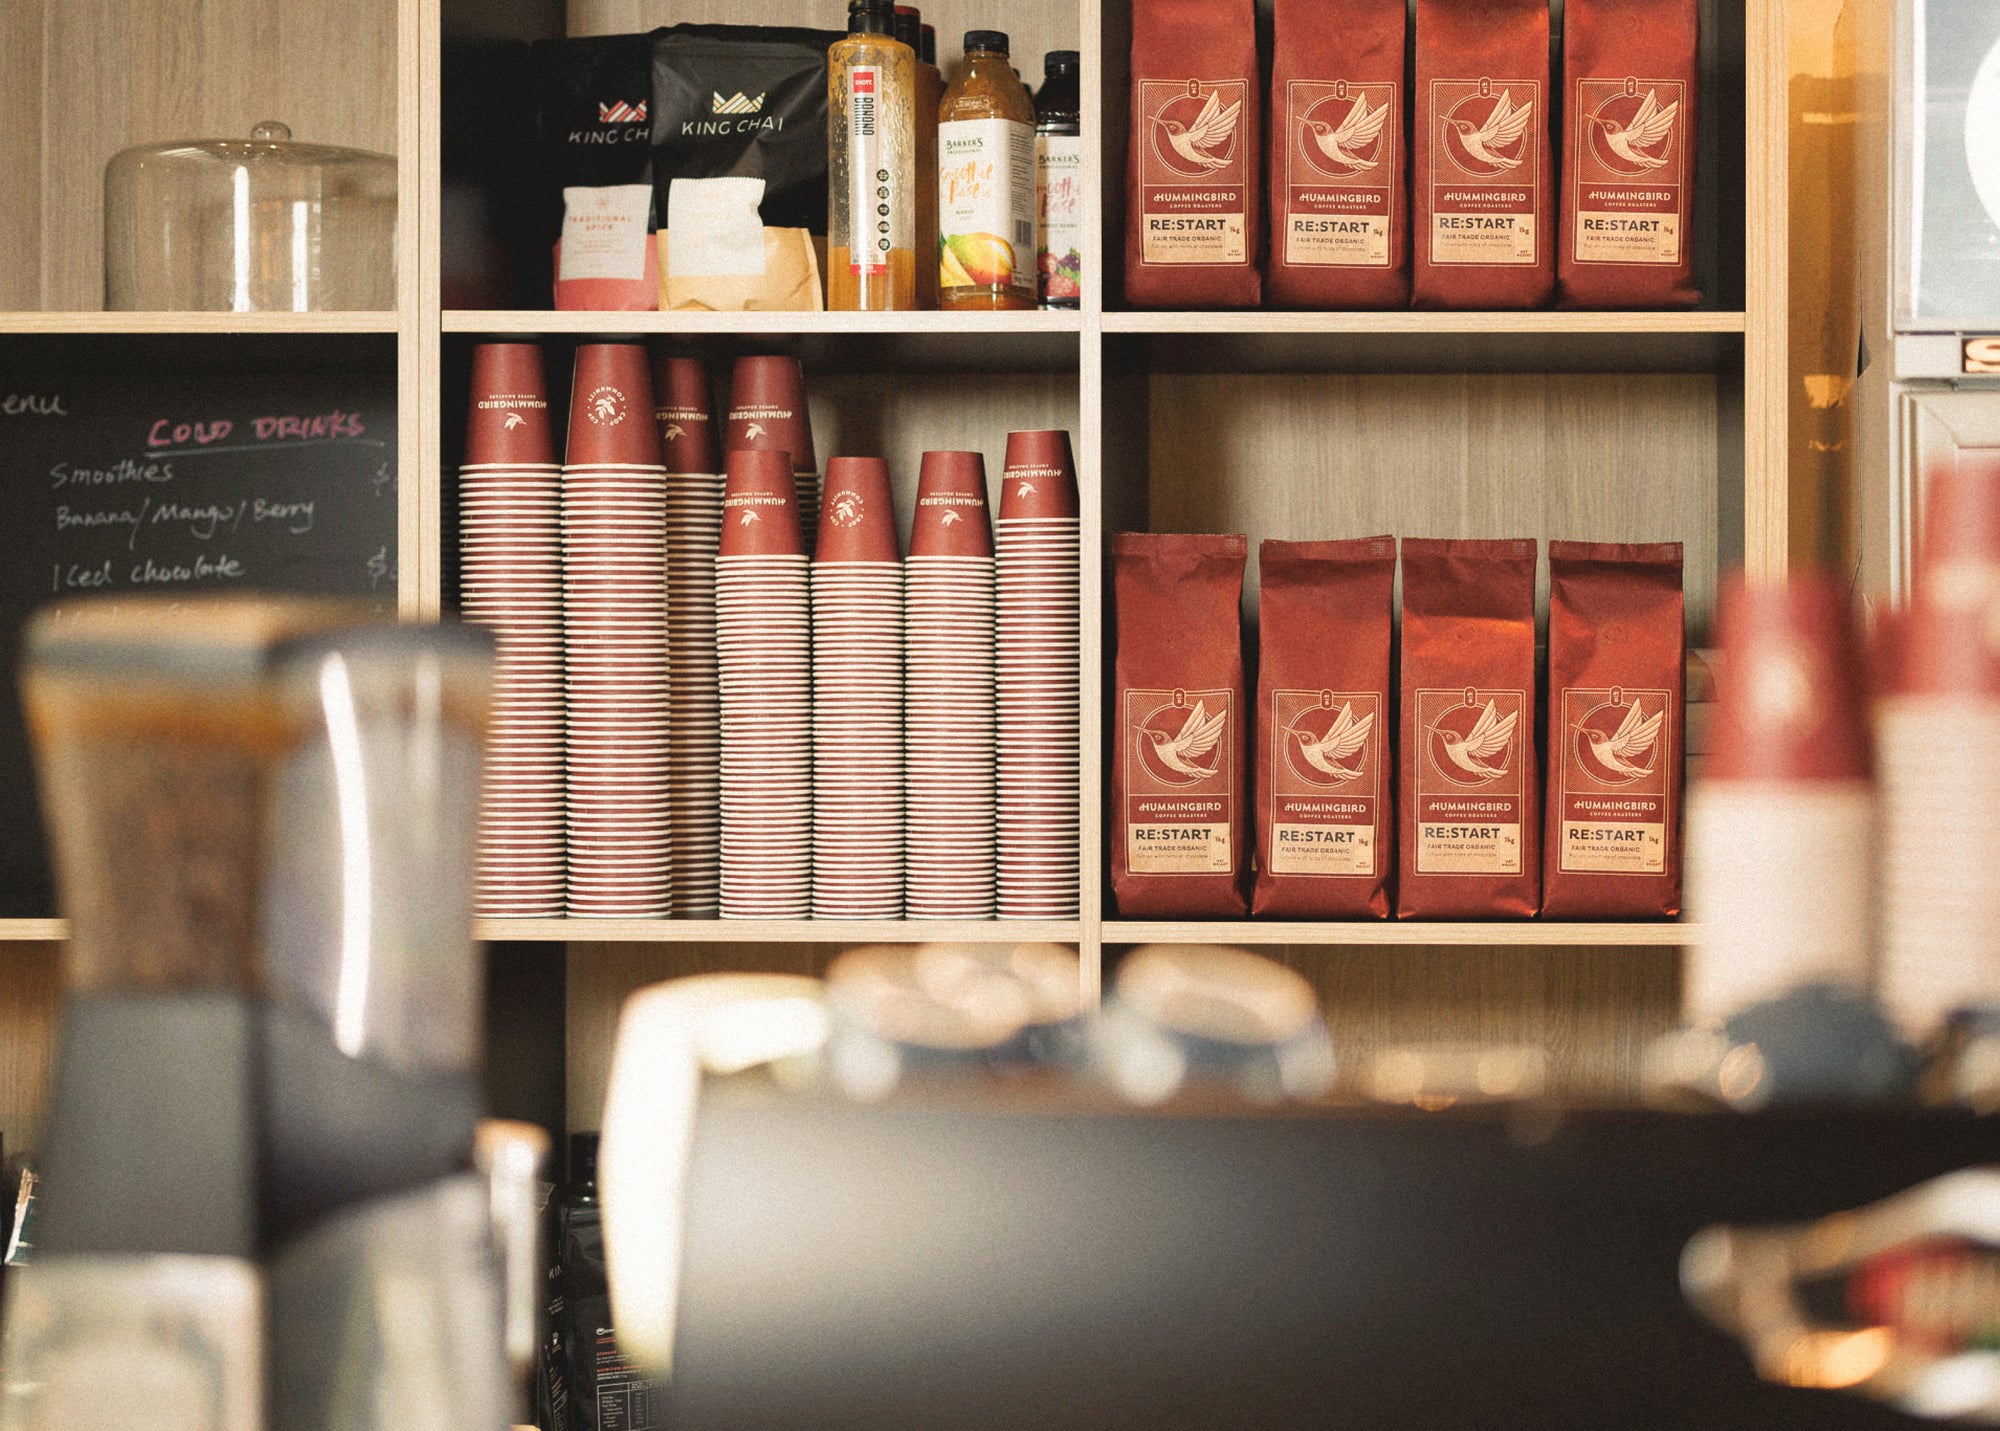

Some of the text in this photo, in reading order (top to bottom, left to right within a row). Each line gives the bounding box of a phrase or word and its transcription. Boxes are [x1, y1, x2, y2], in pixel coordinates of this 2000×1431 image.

[682, 116, 783, 136] KING CHAI
[568, 128, 649, 144] KING CH
[946, 137, 983, 150] BARKER'S
[1153, 192, 1237, 202] HUMMINGBIRD
[1299, 193, 1381, 203] HUMMINGBIRD
[1444, 192, 1527, 202] HUMMINGBIRD
[1588, 191, 1671, 201] HUMMINGBIRD
[1150, 219, 1226, 230] RE:START
[1294, 220, 1369, 233] RE:START
[1440, 217, 1515, 229] RE:START
[1584, 218, 1660, 232] RE:START
[587, 386, 626, 402] COMMUNITY
[1, 394, 68, 416] enu
[478, 400, 547, 409] HUMMINGBIRD
[147, 409, 367, 447] COLD DRINKS
[50, 458, 174, 490] Smoothies
[920, 497, 984, 507] HUMMINGBIRD
[53, 560, 112, 592] Iced
[131, 553, 246, 584] chocolate
[1138, 802, 1222, 812] HUMMINGBIRD
[1284, 802, 1367, 813] HUMMINGBIRD
[1429, 802, 1512, 812] HUMMINGBIRD
[1574, 801, 1656, 811] HUMMINGBIRD
[1135, 829, 1212, 840] RE:START
[1279, 830, 1355, 843] RE:START
[1425, 827, 1500, 839] RE:START
[1569, 829, 1645, 841] RE:START
